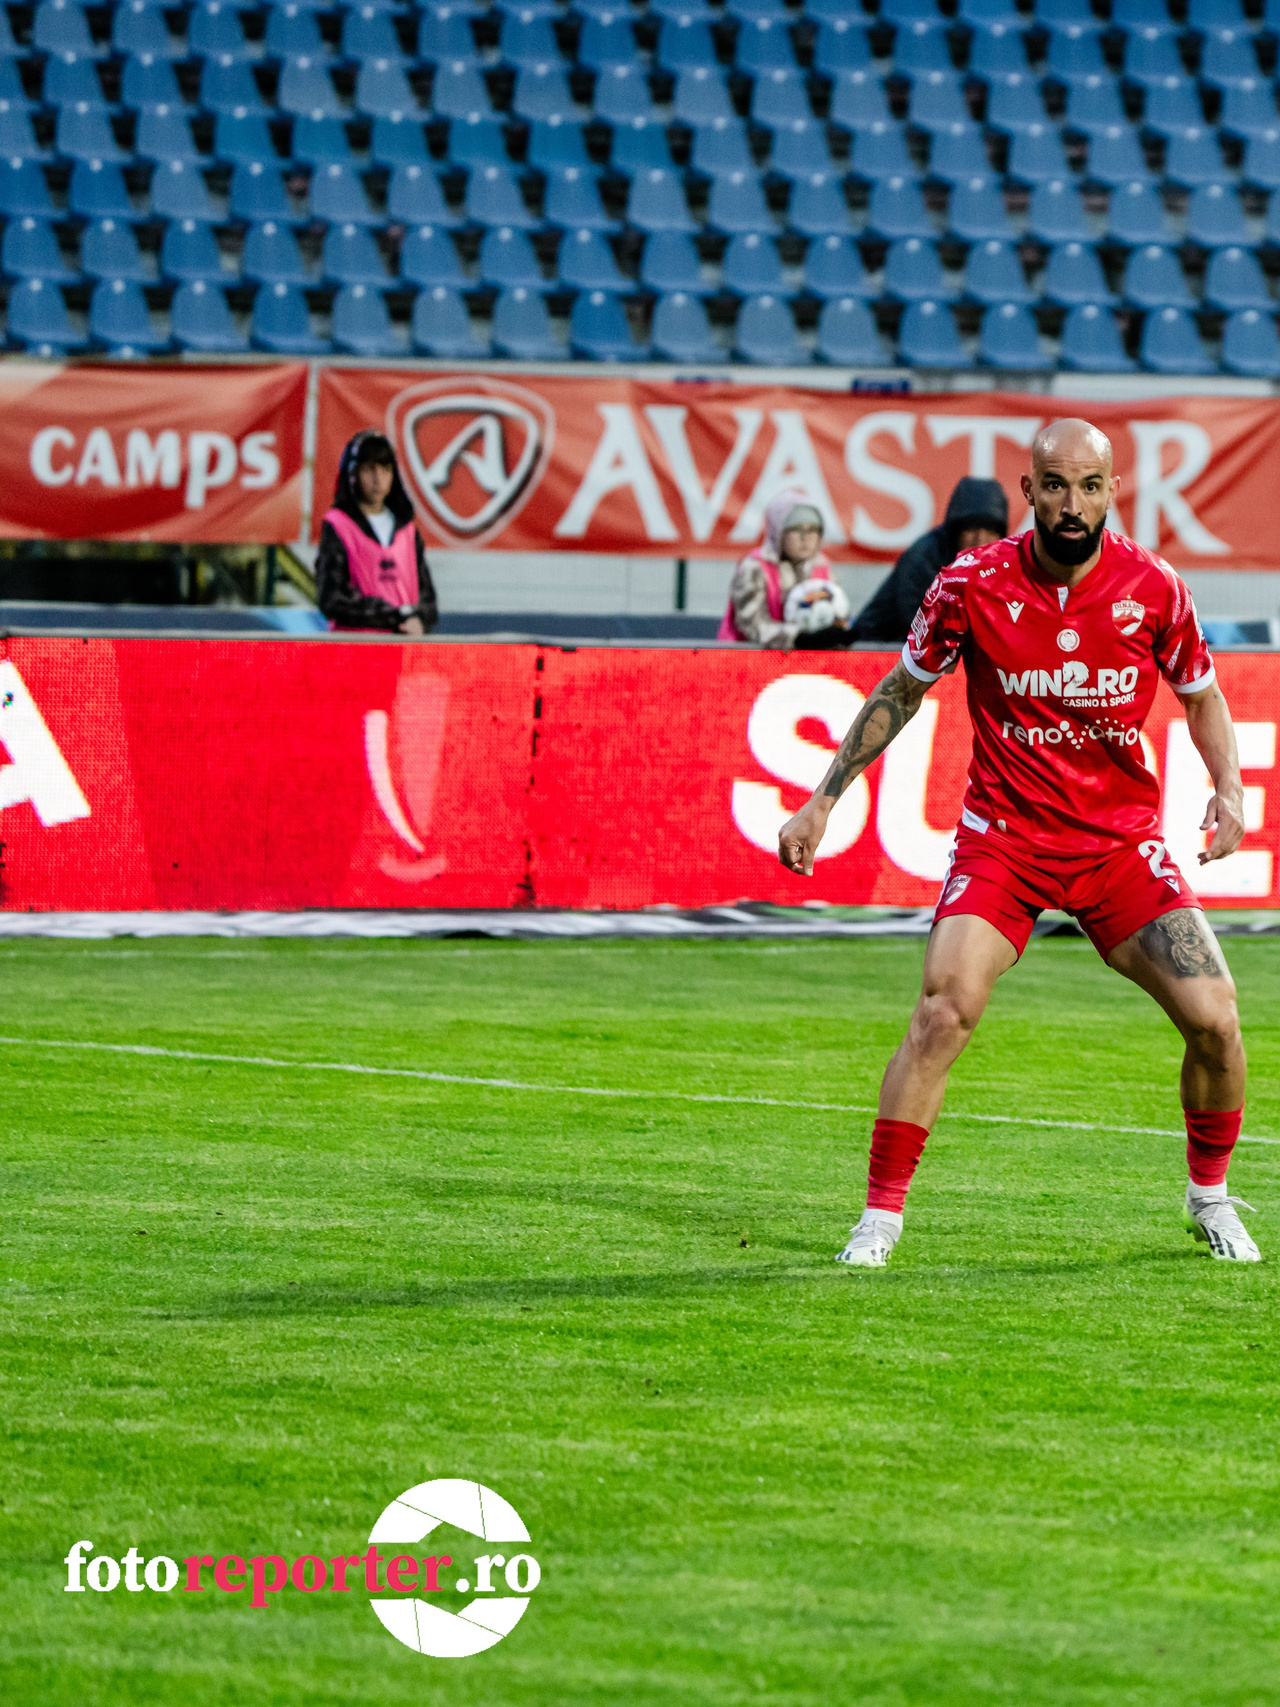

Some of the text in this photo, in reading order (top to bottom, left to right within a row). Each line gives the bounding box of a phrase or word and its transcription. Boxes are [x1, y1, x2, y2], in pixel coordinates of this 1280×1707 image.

[30, 425, 280, 508] CAMPS
[554, 402, 1232, 555] AVASTR
[996, 660, 1139, 698] WIN2.RO
[1062, 692, 1137, 708] CASINO & SPORT
